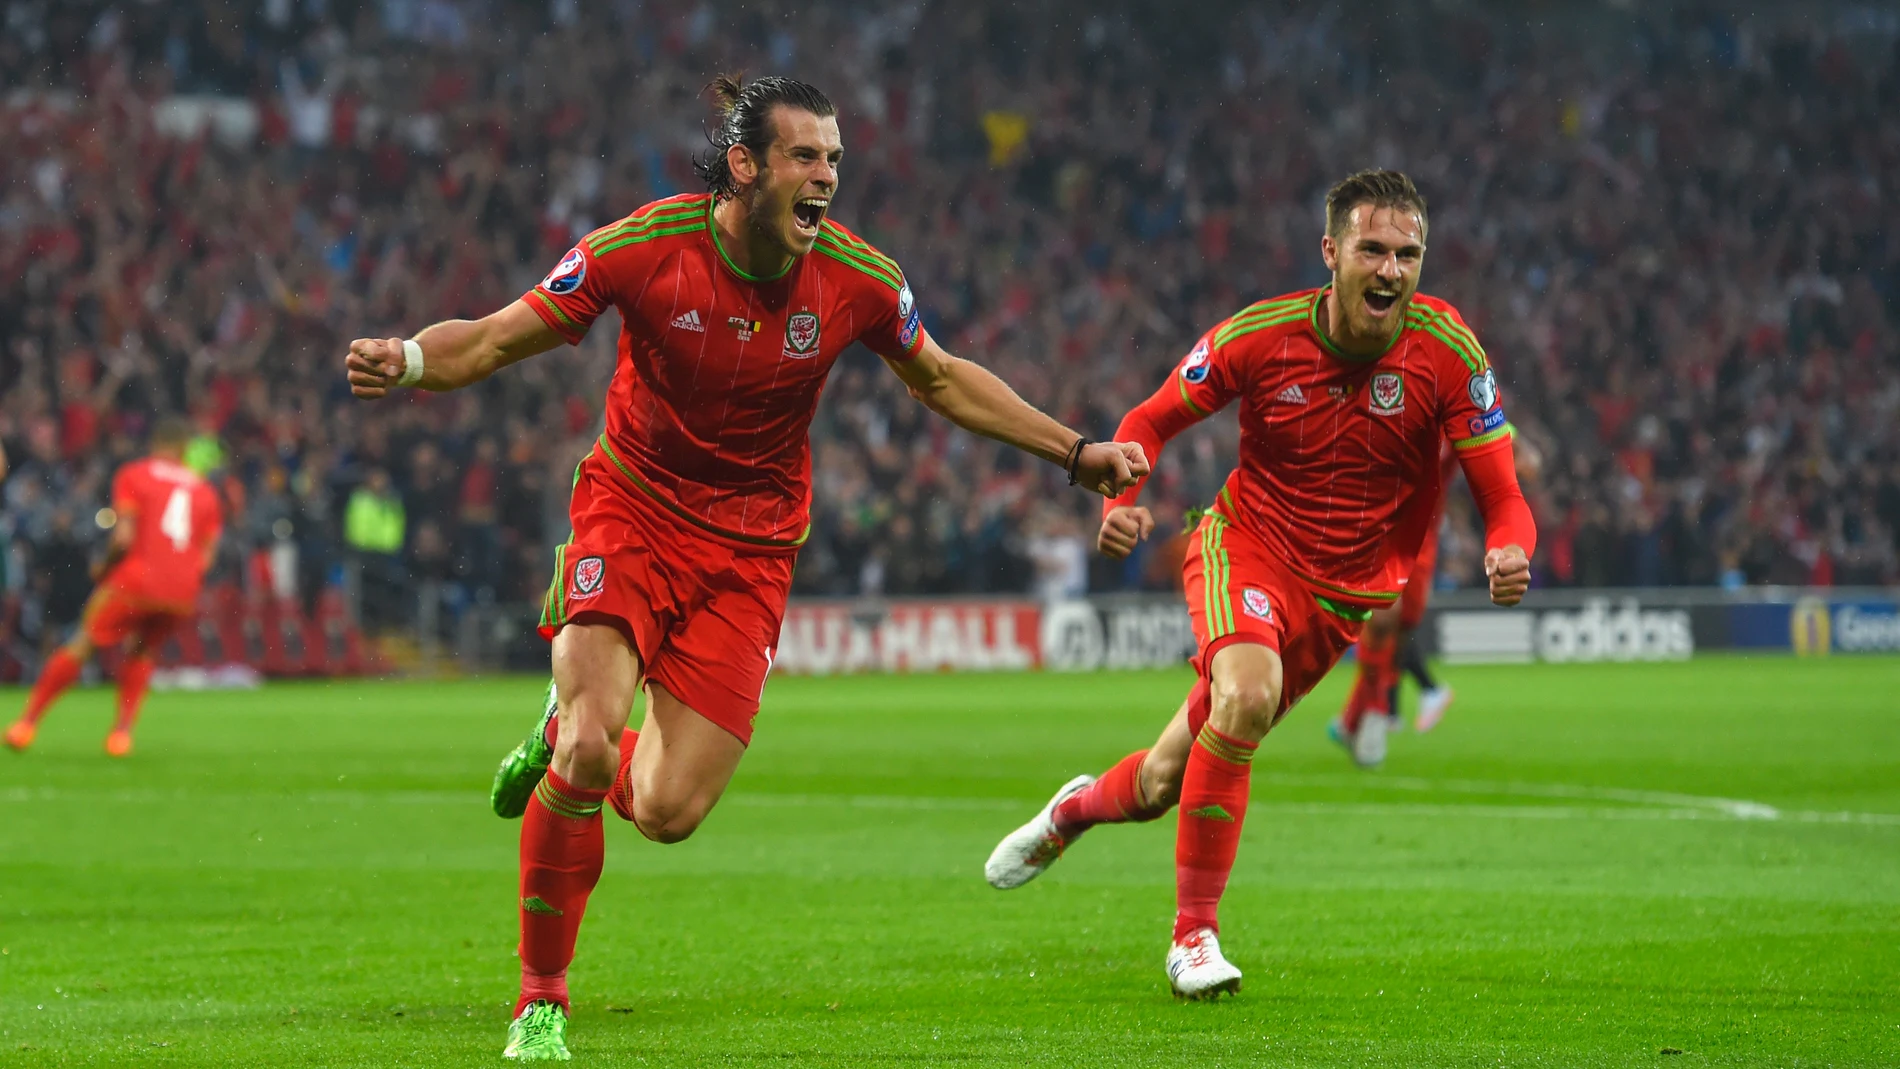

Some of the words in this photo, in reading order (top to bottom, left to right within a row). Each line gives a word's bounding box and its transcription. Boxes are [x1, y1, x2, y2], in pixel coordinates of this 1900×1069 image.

[671, 319, 705, 333] adidas
[161, 488, 191, 552] 4
[777, 607, 1031, 670] AUXHALL
[1540, 598, 1693, 663] adidas
